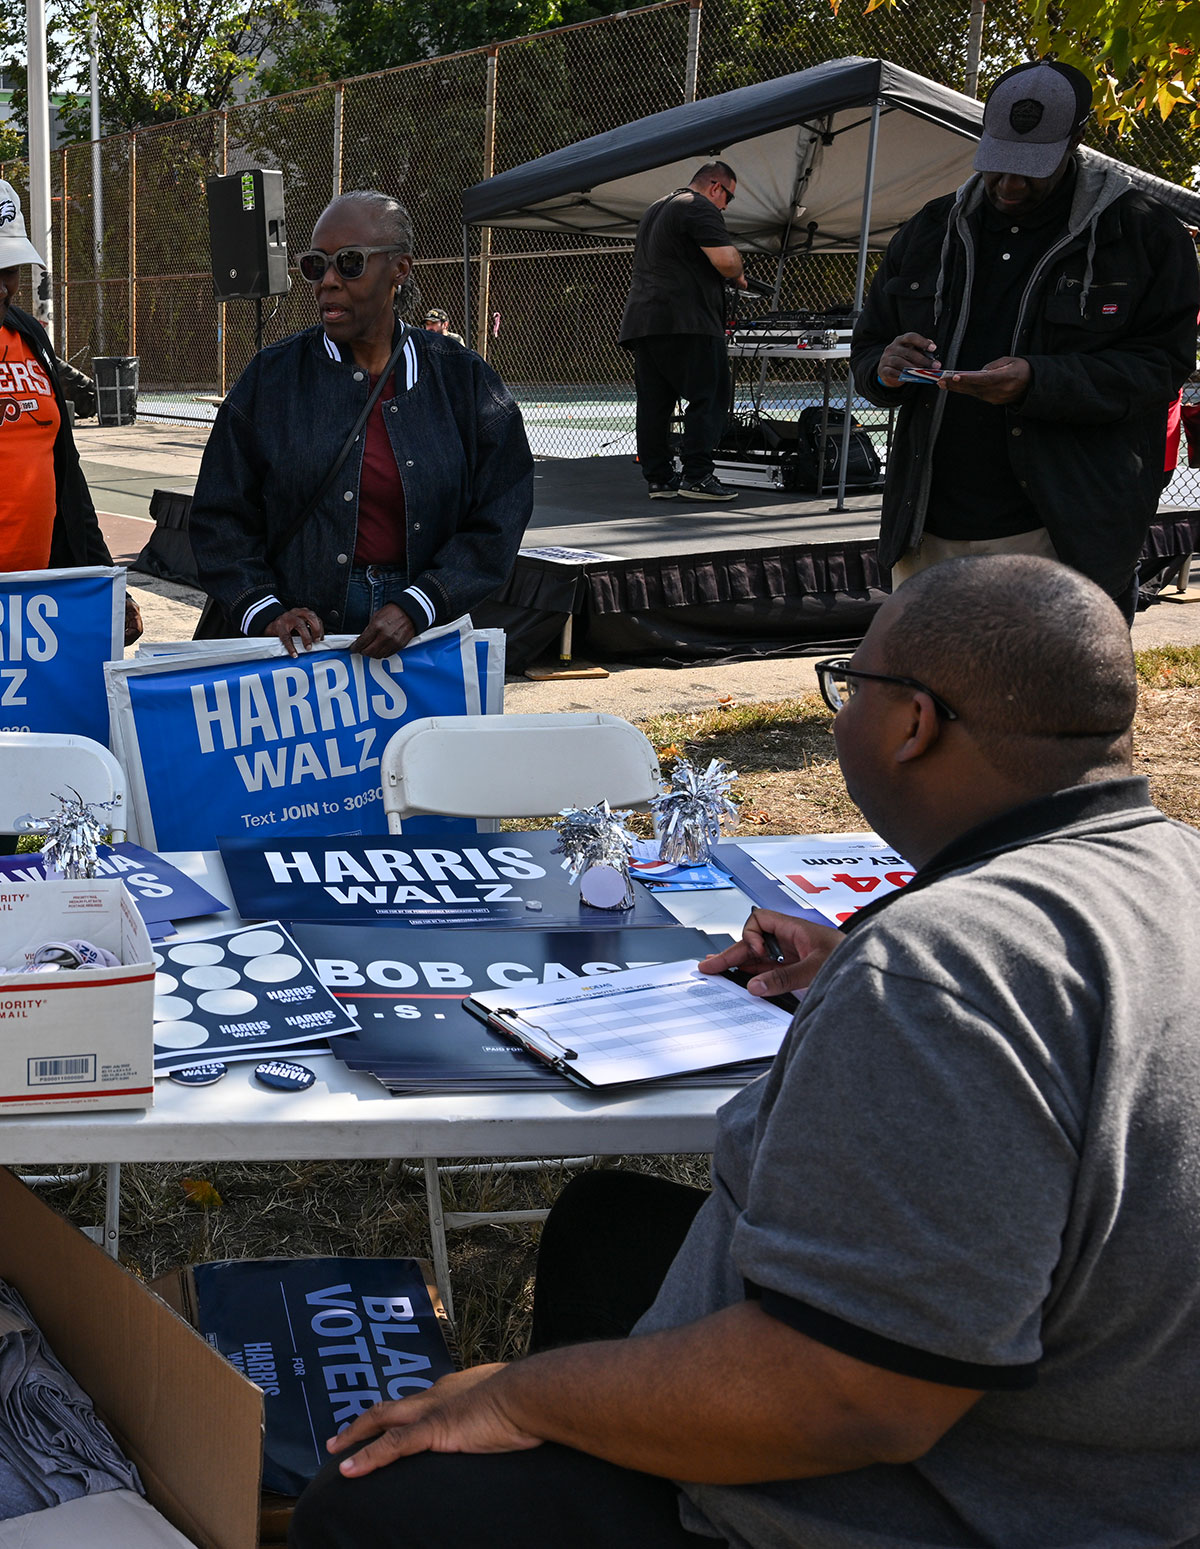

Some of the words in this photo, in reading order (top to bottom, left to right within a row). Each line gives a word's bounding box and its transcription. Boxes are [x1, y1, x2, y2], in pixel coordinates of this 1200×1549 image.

[190, 652, 408, 754] HARRIS
[233, 727, 380, 792] WALZ
[241, 811, 277, 828] Text
[280, 802, 319, 821] JOIN
[322, 800, 339, 814] to
[263, 847, 547, 884] HARRIS
[802, 856, 906, 866] EY.com
[323, 883, 524, 905] WALZ
[314, 958, 473, 988] BOB
[266, 985, 316, 1000] HARRIS
[279, 994, 313, 1003] WALZ
[219, 1020, 271, 1034] HARRIS
[284, 1010, 336, 1026] HARRIS
[298, 1019, 333, 1029] WALZ
[232, 1029, 267, 1038] WALZ
[181, 1068, 219, 1077] WALZ
[256, 1063, 311, 1083] HARRIS
[361, 1296, 435, 1400] BLAC
[291, 1357, 306, 1377] FOR
[305, 1283, 383, 1436] VOTER
